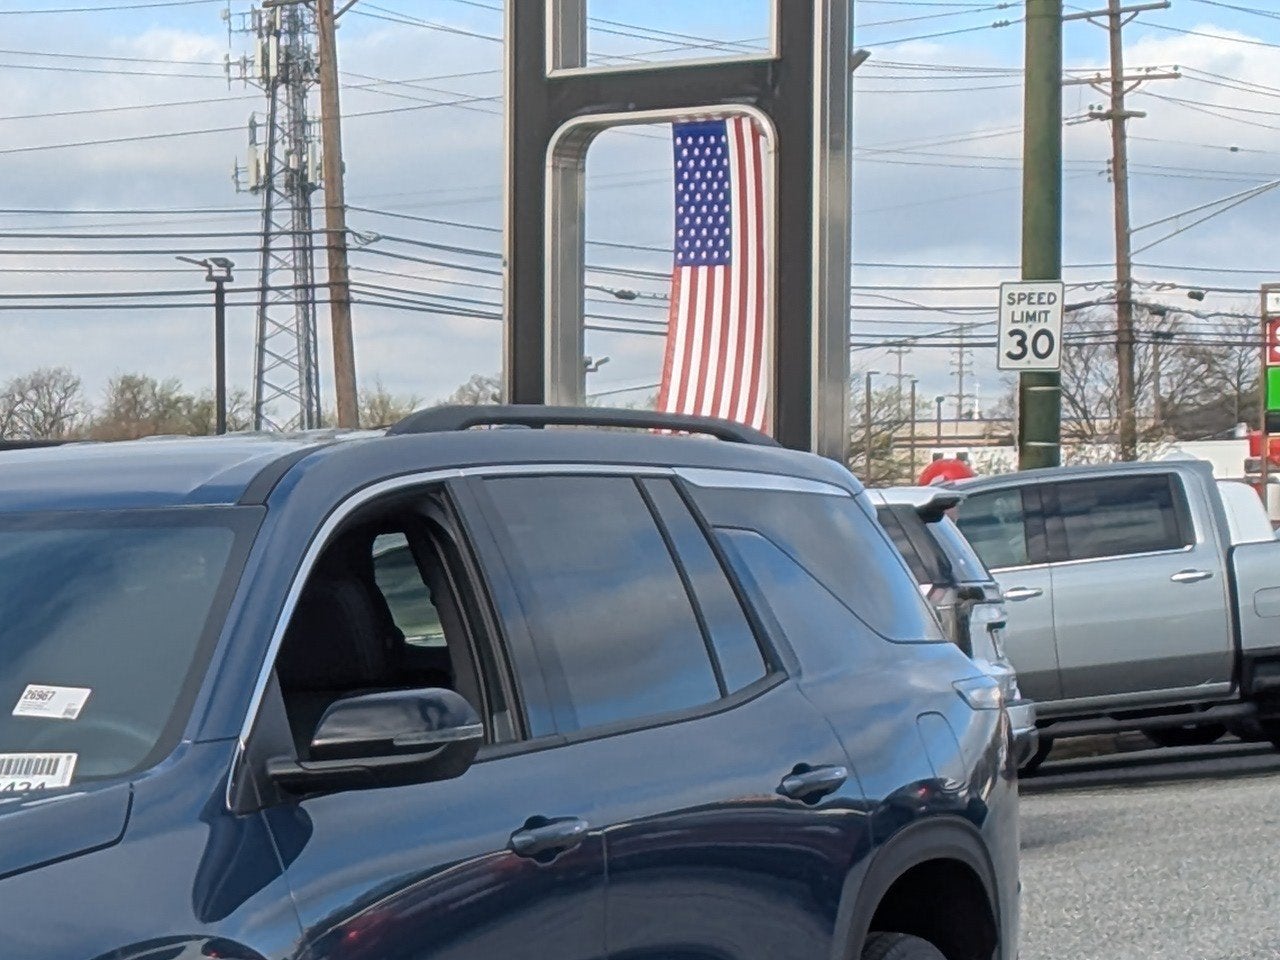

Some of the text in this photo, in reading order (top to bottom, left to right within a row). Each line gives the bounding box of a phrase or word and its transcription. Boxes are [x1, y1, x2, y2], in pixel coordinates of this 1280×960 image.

[1006, 291, 1058, 306] SPEED
[1010, 309, 1051, 324] LIMIT
[1005, 328, 1055, 361] 30
